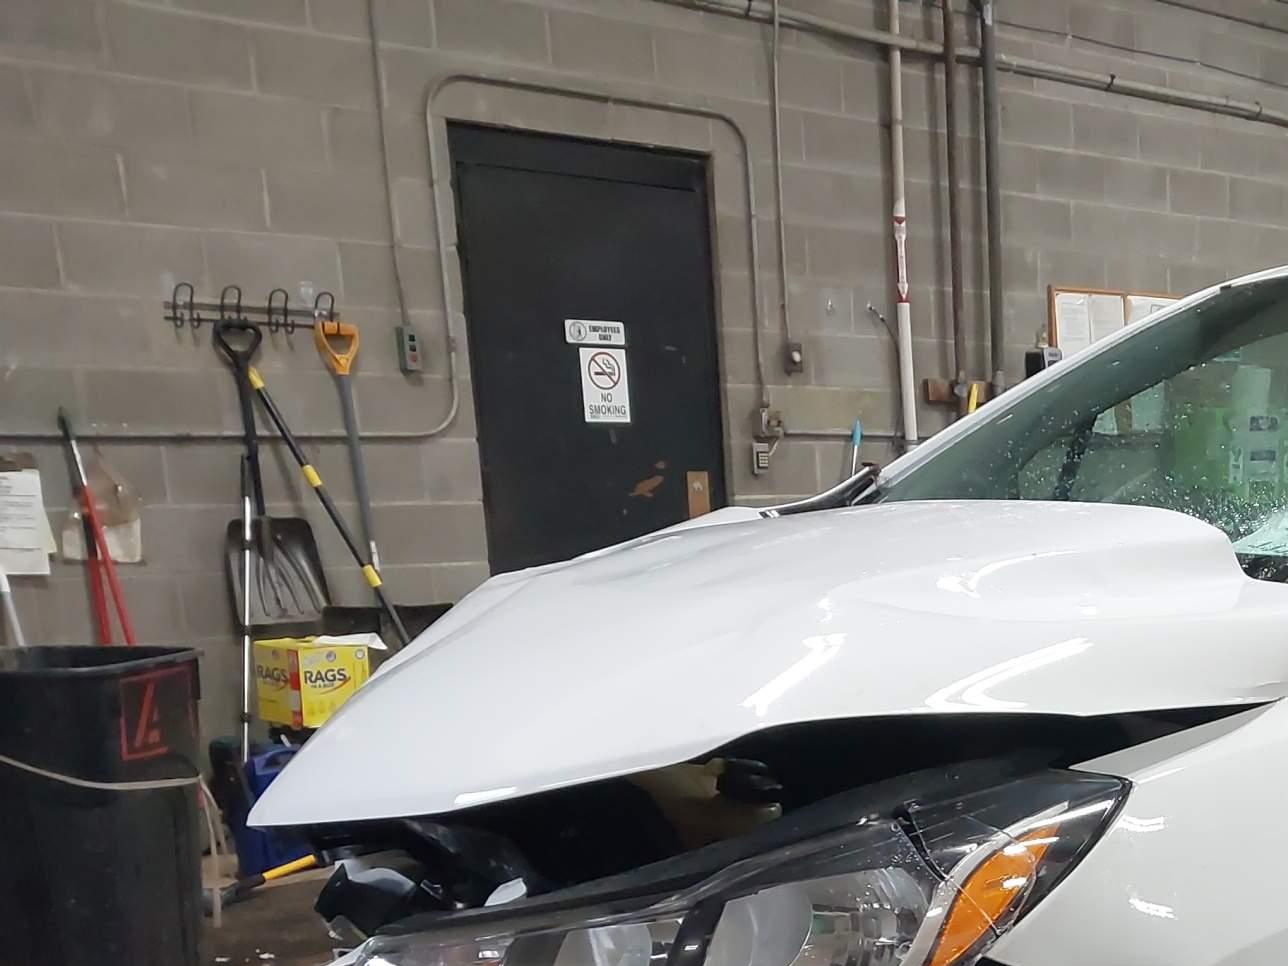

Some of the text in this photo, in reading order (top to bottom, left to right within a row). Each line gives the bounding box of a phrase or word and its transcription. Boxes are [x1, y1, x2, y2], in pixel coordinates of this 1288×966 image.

[589, 325, 620, 334] EMPLOYEES
[598, 333, 612, 341] ONLY
[601, 393, 613, 403] NO
[588, 404, 626, 415] SMOKING
[257, 664, 289, 681] RAGS
[304, 668, 347, 684] RAGS
